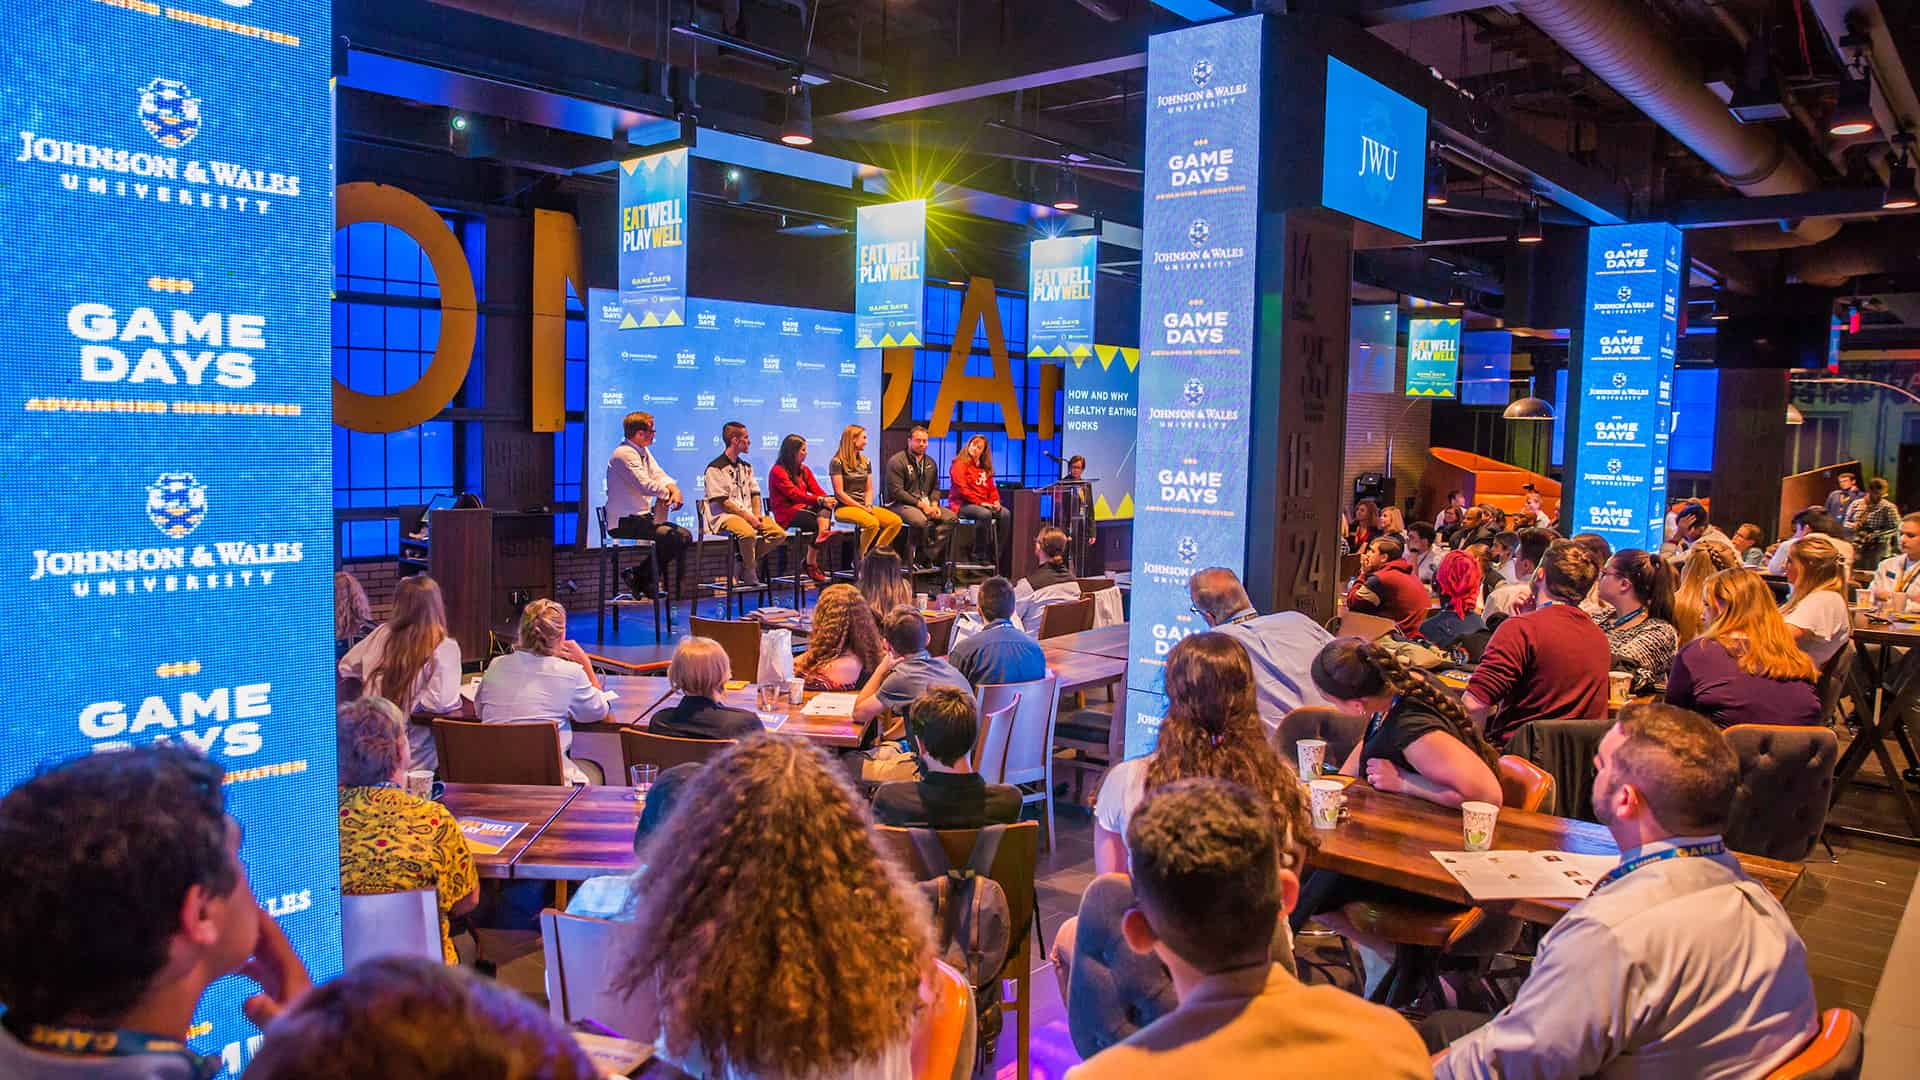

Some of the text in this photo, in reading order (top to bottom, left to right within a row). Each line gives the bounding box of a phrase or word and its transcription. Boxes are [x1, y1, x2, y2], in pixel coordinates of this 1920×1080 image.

[1157, 90, 1204, 108] JOHNSON
[1214, 83, 1248, 97] WALES
[17, 131, 300, 196] JOHNSON & WALES
[1168, 149, 1233, 170] GAME
[1359, 135, 1398, 181] JWU
[1171, 166, 1229, 187] DAYS
[60, 172, 270, 214] UNIVERSITY
[1153, 250, 1200, 264] JOHNSON
[1211, 248, 1244, 258] WALES
[1604, 249, 1648, 259] GAME
[1606, 258, 1646, 269] DAYS
[67, 302, 266, 349] GAME
[1163, 312, 1229, 328] GAME
[1166, 328, 1224, 345] DAYS
[1599, 335, 1644, 345] GAME
[1601, 344, 1641, 354] DAYS
[80, 344, 256, 388] DAYS
[1068, 390, 1129, 401] HOW AND WHY
[1067, 406, 1137, 417] HEALTHY EATING
[1149, 407, 1195, 421] JOHNSON
[1206, 408, 1238, 420] WALES
[1067, 421, 1099, 431] WORKS
[1594, 421, 1638, 432] GAME
[1596, 431, 1635, 441] DAYS
[1158, 469, 1222, 487] GAME
[1161, 486, 1218, 504] DAYS
[1589, 506, 1633, 518] GAME
[1591, 516, 1630, 527] DAYS
[30, 542, 303, 580] JOHNSON & WALES
[72, 569, 274, 597] UNIVERSITY
[78, 682, 272, 739] GAME
[91, 722, 263, 757] YS
